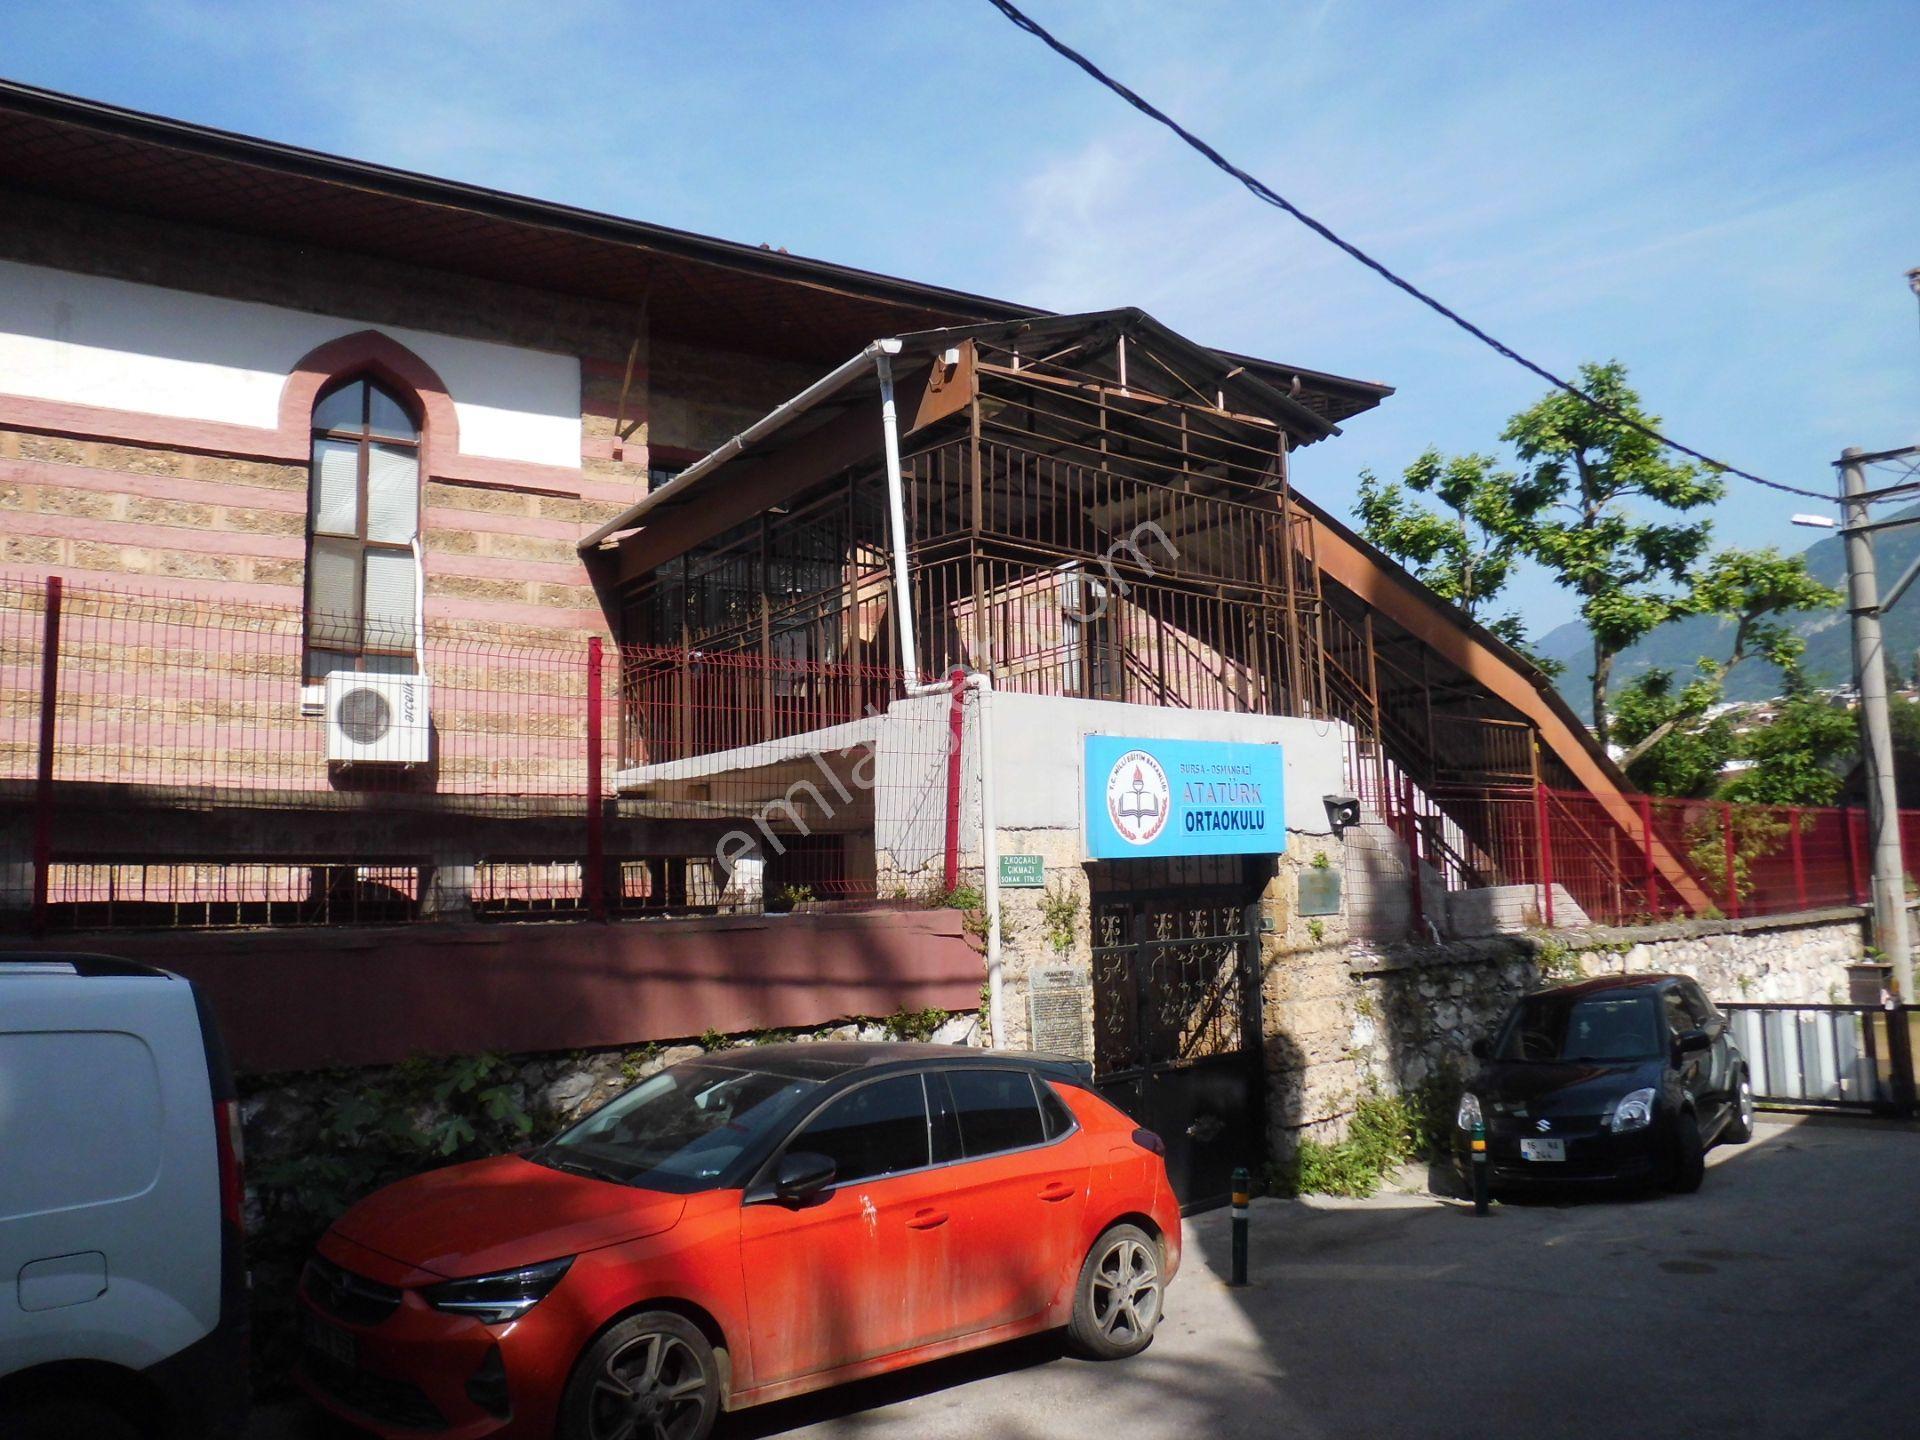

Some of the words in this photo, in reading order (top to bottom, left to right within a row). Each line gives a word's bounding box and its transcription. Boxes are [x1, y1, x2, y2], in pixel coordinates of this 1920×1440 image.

[1180, 763, 1205, 774] BURSA
[1183, 777, 1262, 803] ATATÜRK
[1185, 810, 1265, 832] ORTAOKULU
